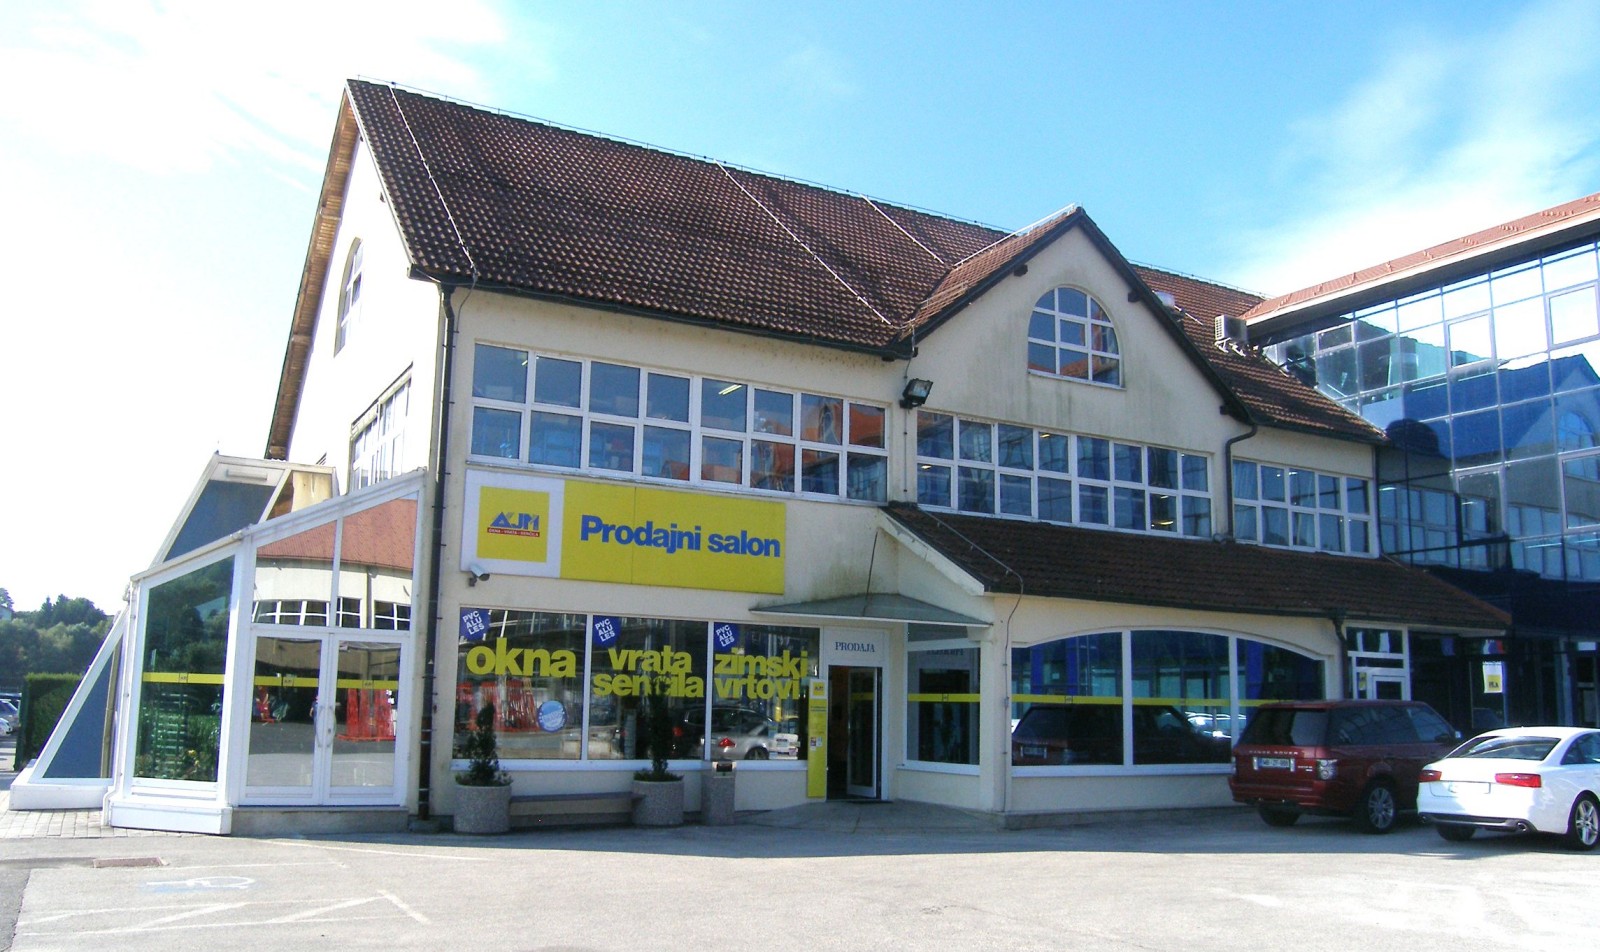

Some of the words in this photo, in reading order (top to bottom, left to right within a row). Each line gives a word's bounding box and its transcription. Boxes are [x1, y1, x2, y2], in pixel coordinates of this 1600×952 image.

[490, 512, 539, 530] AJM
[580, 514, 702, 554] Prodajni
[707, 530, 781, 557] salon
[462, 610, 480, 622] PVC
[465, 616, 482, 628] ALU
[468, 622, 485, 635] LES
[594, 618, 611, 629] PVC
[598, 624, 613, 636] ALU
[600, 630, 616, 642] LES
[715, 624, 730, 636] PVC
[719, 630, 733, 641] ALU
[720, 636, 735, 647] LES
[835, 641, 876, 653] PRODAJA
[466, 637, 577, 678] okna
[607, 644, 692, 674] vrata
[714, 647, 808, 680] zimski
[714, 674, 800, 700] vrtovi
